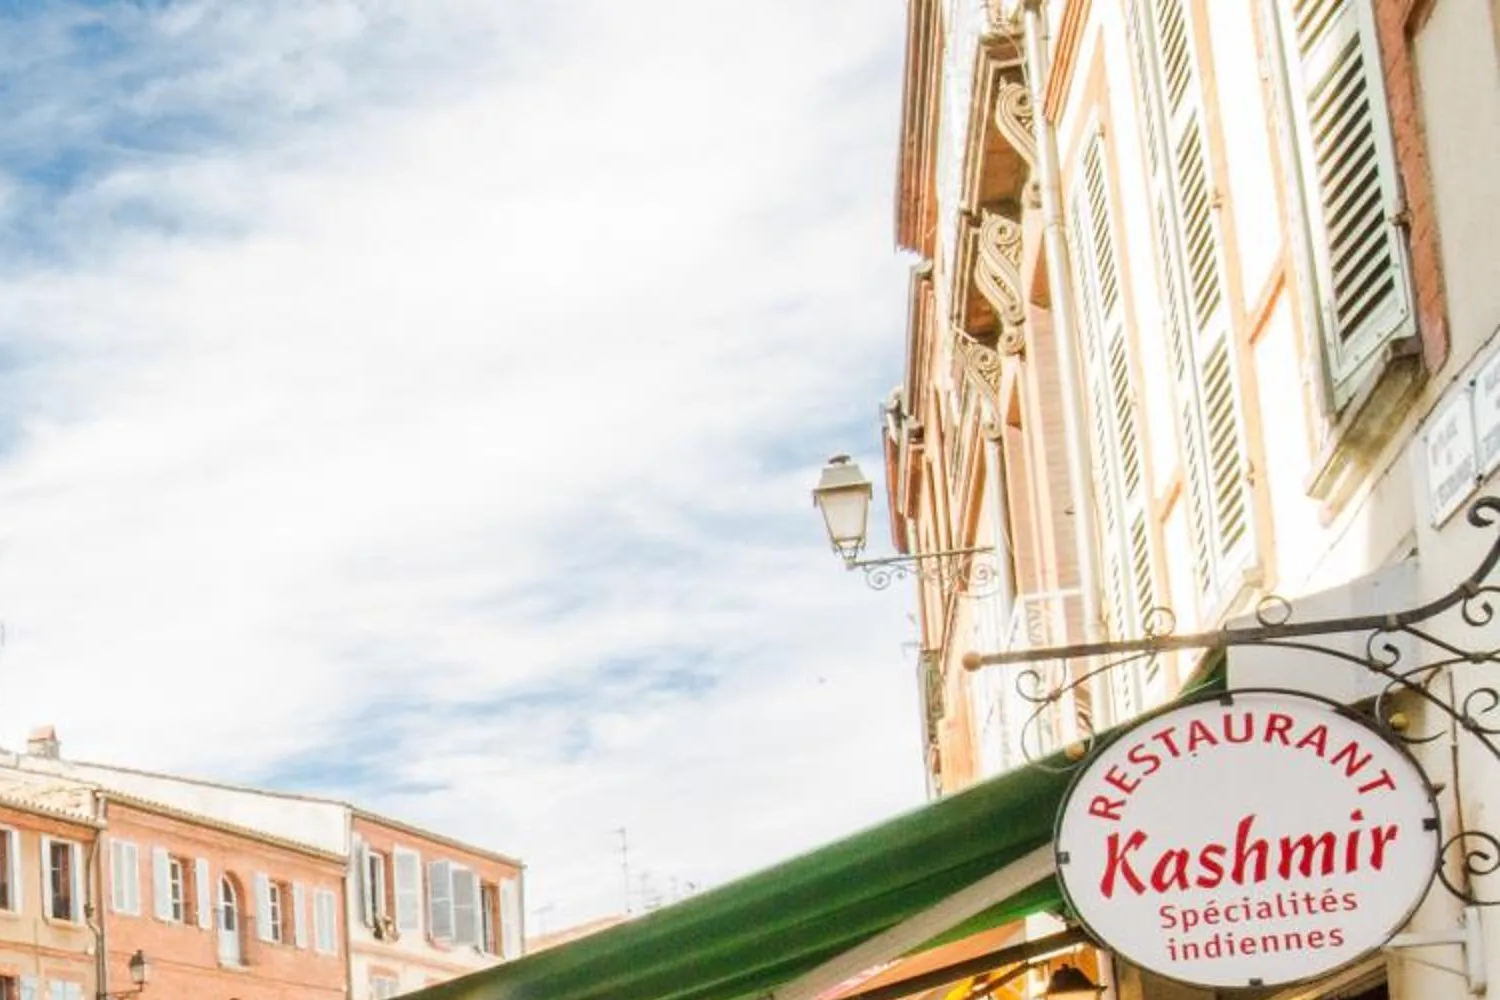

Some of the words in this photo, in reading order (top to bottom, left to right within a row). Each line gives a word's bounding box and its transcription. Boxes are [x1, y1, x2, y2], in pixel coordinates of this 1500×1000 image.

[1088, 712, 1397, 821] RESTAURANT
[1100, 809, 1398, 898] Kashmir
[1158, 888, 1359, 933] Spécialités
[1167, 927, 1345, 961] indiennes
